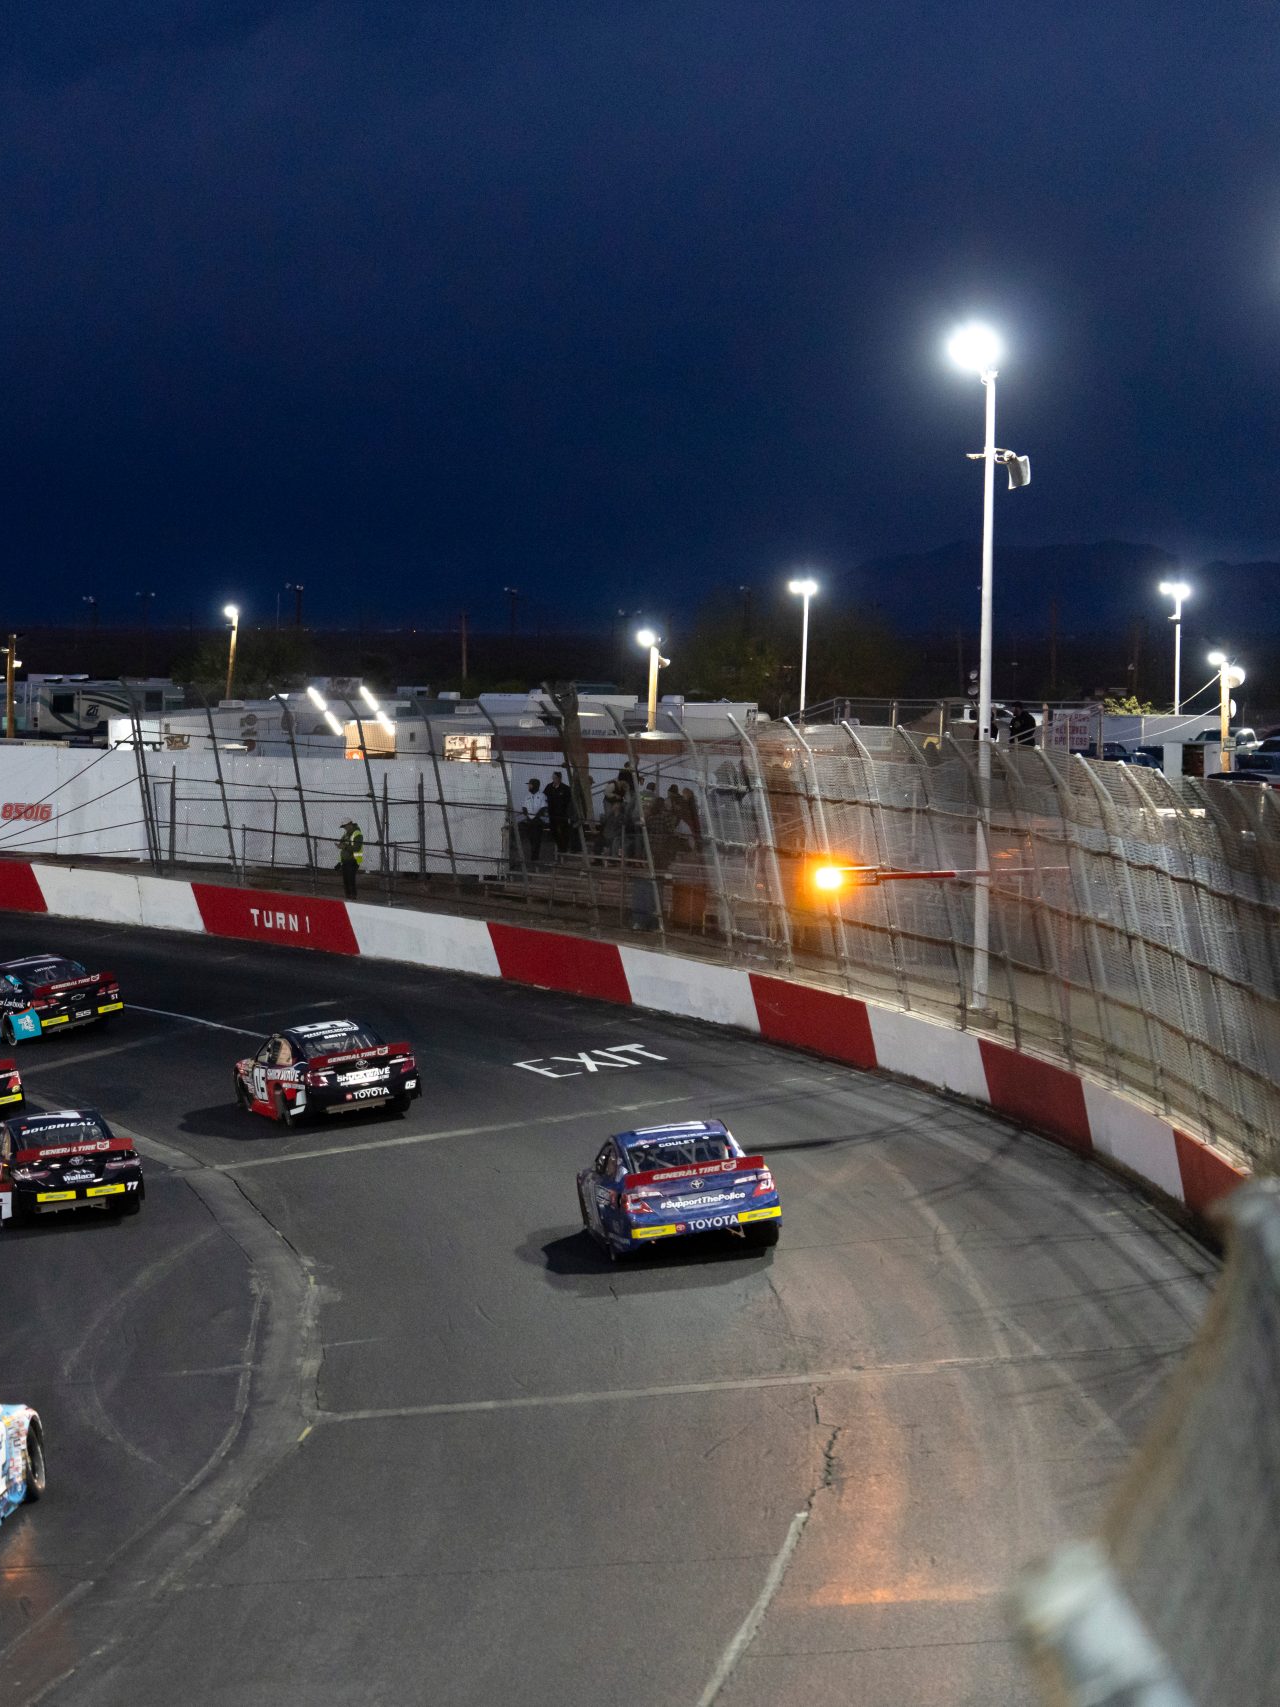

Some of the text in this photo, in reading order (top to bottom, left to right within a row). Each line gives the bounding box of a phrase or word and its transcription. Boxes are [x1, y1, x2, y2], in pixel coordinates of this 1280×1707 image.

[1, 802, 54, 822] 85016
[249, 907, 312, 934] TURN 1
[327, 1050, 377, 1064] GENERAL TIRE
[513, 1042, 668, 1079] EXIT
[336, 1066, 391, 1083] SHOCKWAVE
[404, 1079, 417, 1090] 05
[352, 1086, 390, 1100] TOYOTA
[39, 1145, 78, 1157] GENERAL
[77, 1143, 97, 1153] TIRE
[658, 1138, 696, 1148] GOULET
[62, 1172, 96, 1183] Wallace
[652, 1169, 698, 1181] GENERAL
[698, 1164, 721, 1174] TIRE
[126, 1180, 139, 1191] 77
[660, 1191, 746, 1210] #SupportThePolice
[688, 1214, 739, 1231] TOYOTA
